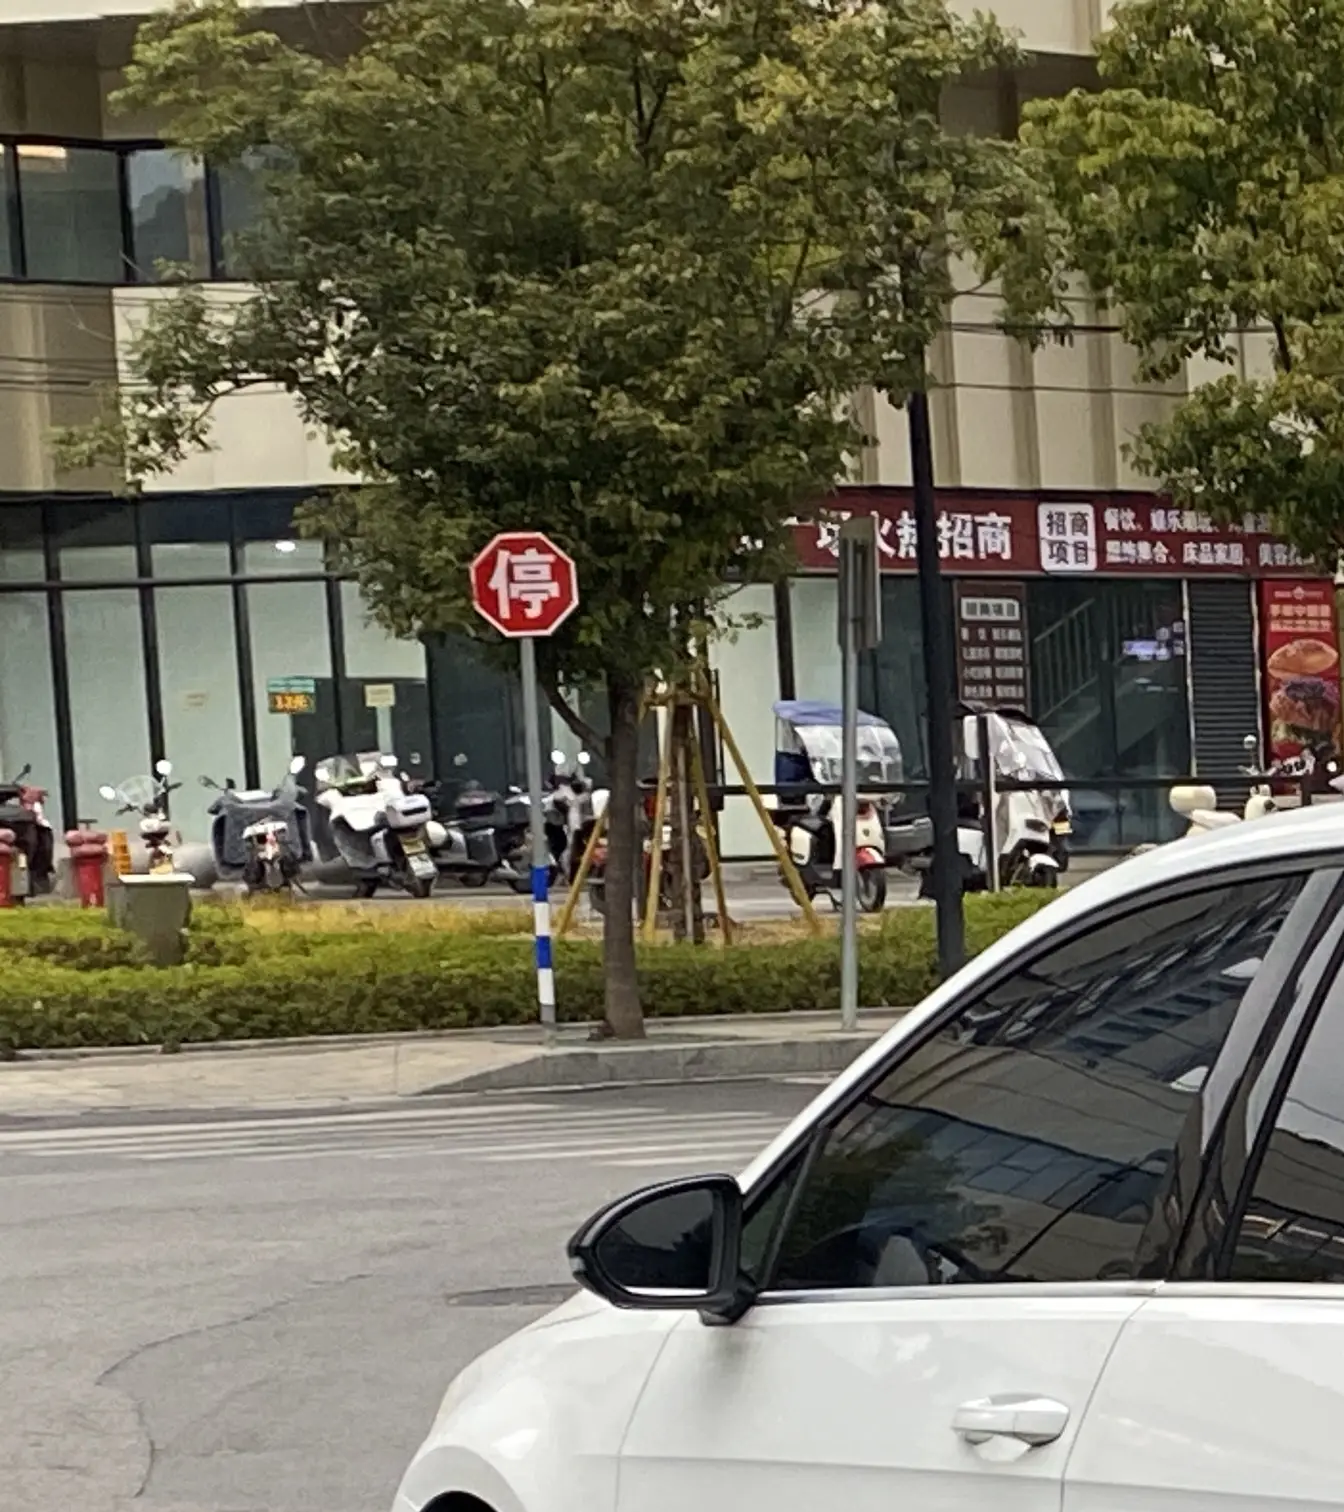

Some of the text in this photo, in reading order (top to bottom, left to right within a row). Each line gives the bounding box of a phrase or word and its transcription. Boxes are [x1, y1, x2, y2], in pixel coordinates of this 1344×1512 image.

[1047, 510, 1089, 537] 招商
[1049, 540, 1089, 565] 项目
[488, 548, 560, 619] 停
